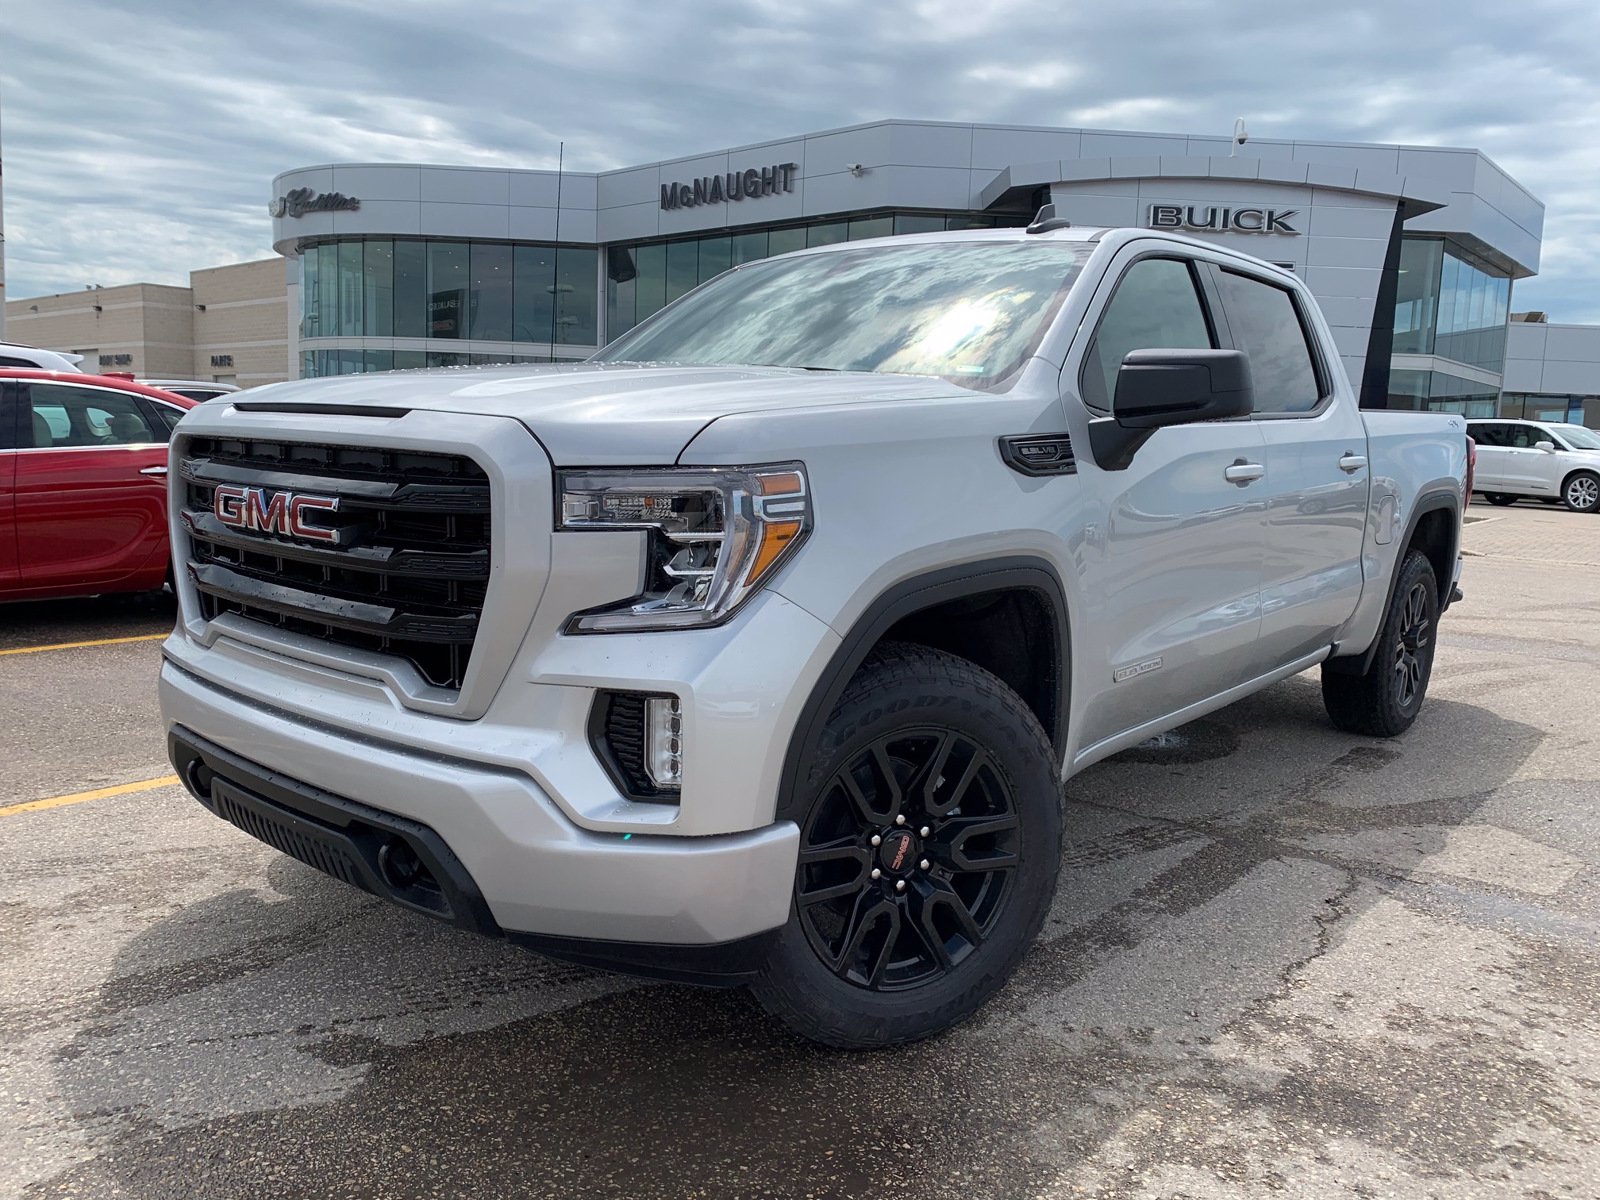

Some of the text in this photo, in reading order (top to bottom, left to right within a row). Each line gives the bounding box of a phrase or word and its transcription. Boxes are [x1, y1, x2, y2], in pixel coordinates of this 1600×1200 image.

[1149, 205, 1302, 235] BUICK
[211, 355, 233, 366] PARTS
[214, 484, 340, 544] GMC
[891, 835, 910, 870] GMC
